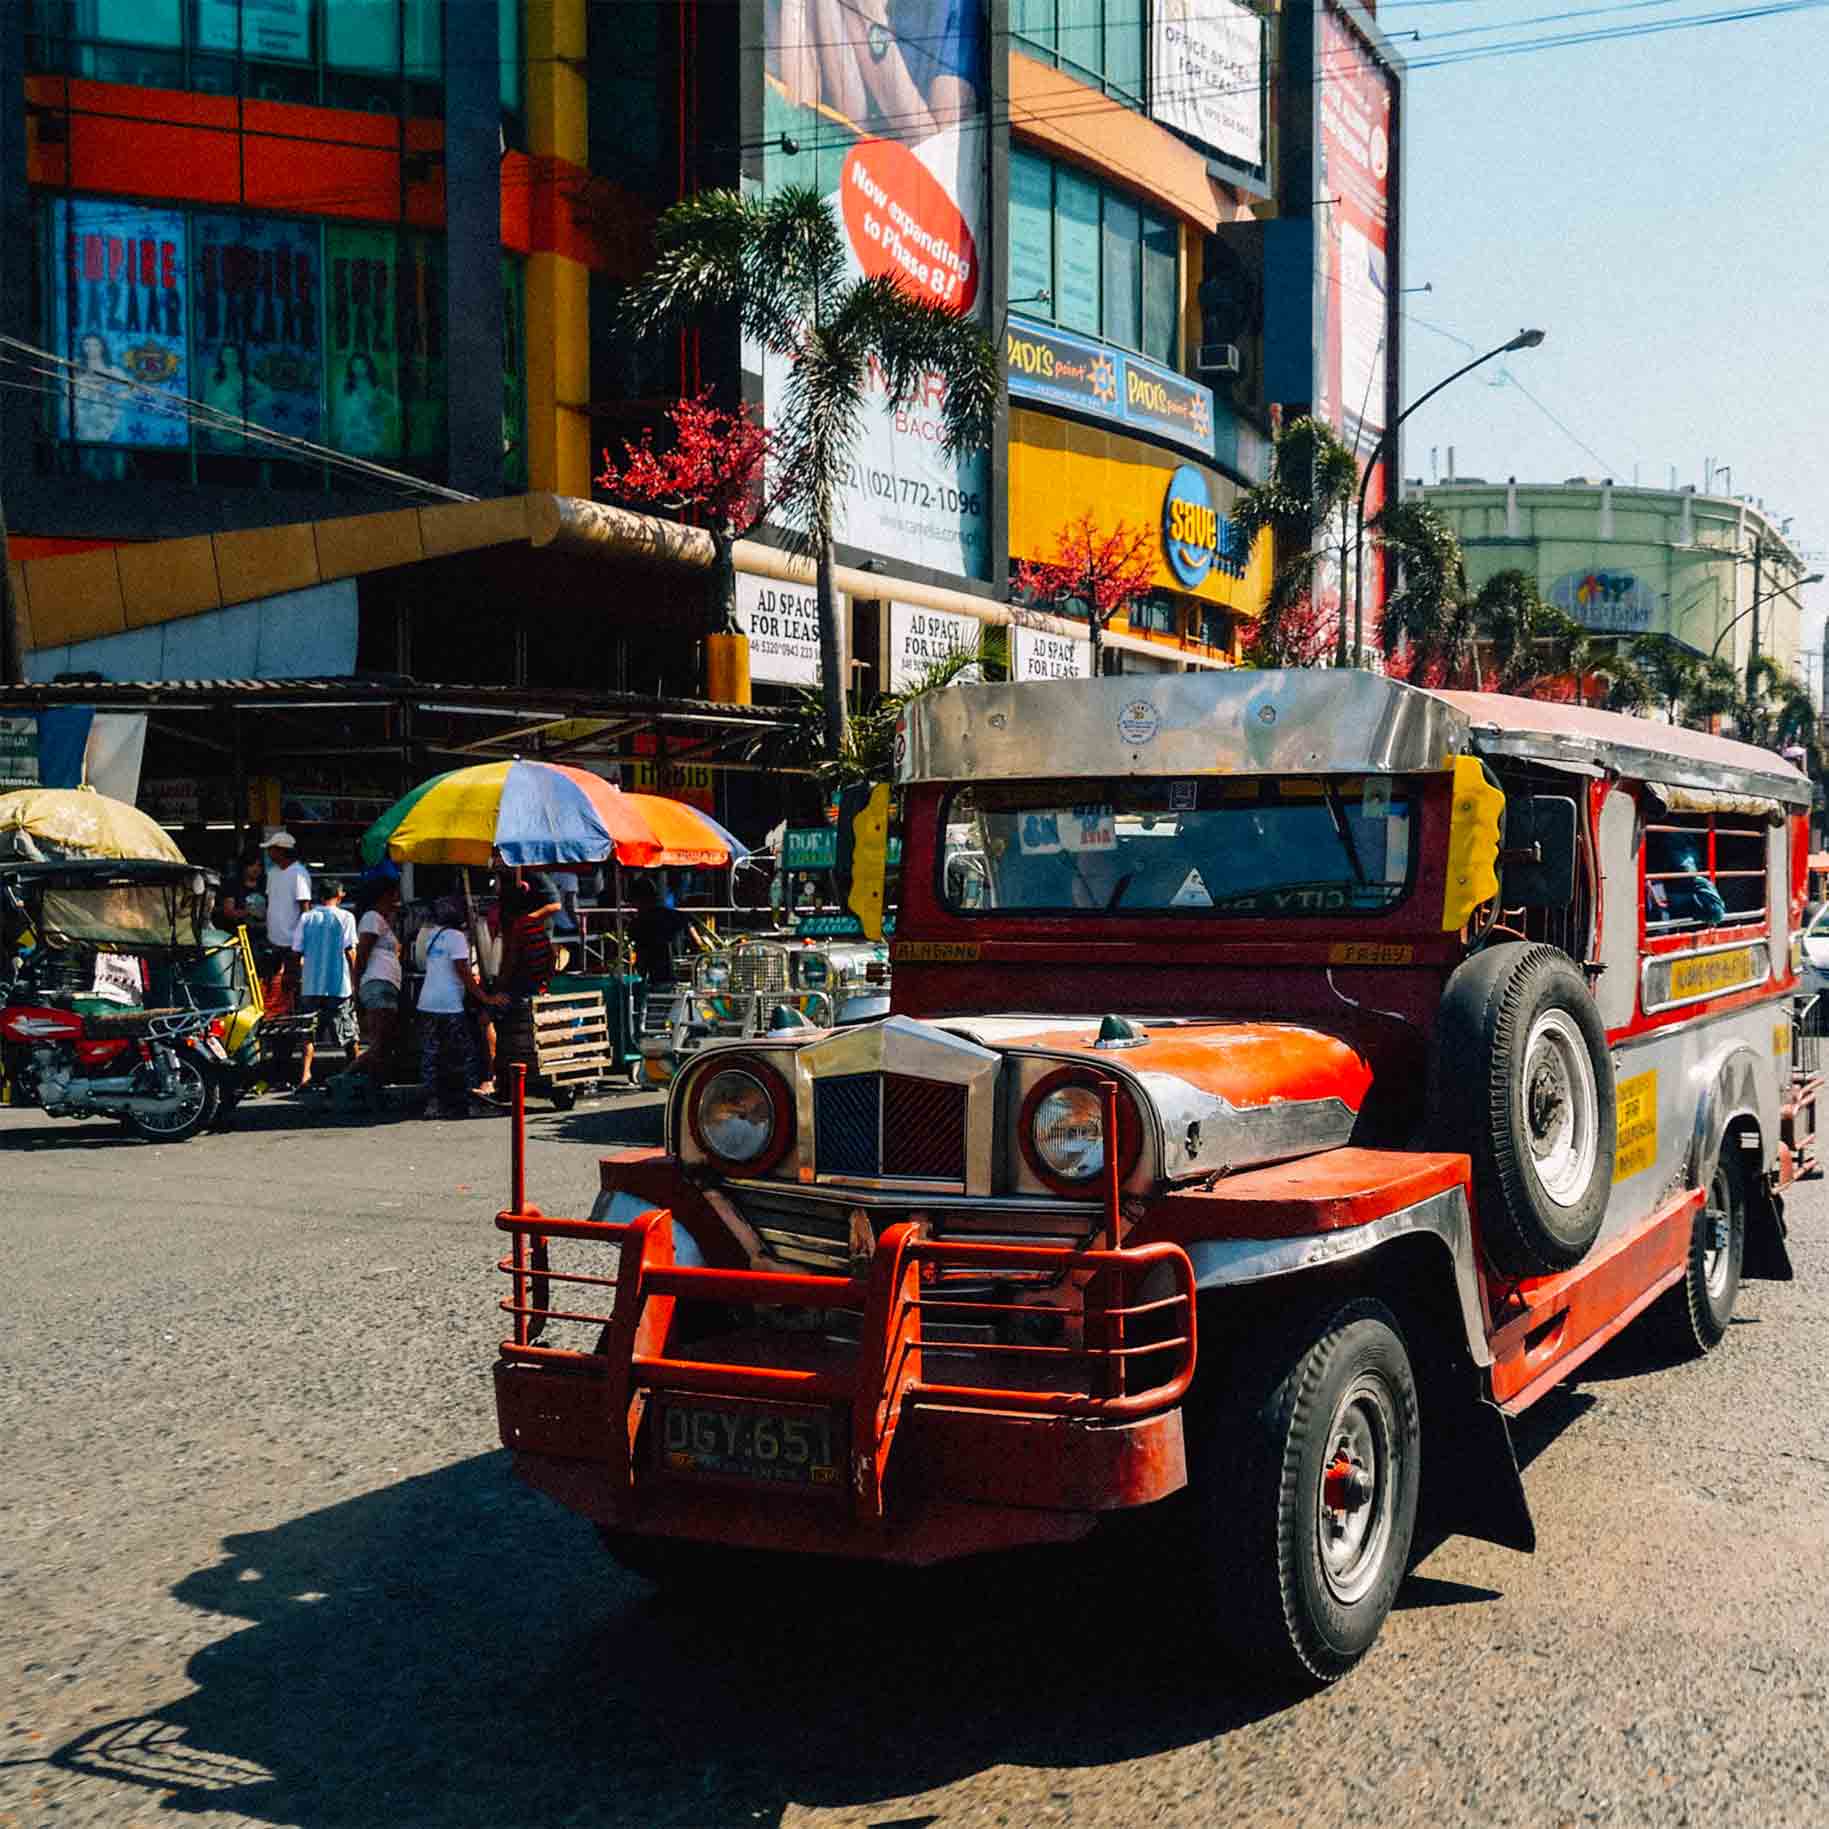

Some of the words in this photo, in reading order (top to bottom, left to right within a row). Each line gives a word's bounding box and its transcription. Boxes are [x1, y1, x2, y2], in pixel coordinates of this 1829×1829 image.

[852, 161, 888, 209] Now
[888, 201, 970, 282] expanding
[864, 212, 881, 241] to
[881, 224, 928, 284] Phase
[930, 267, 956, 300] 8!
[758, 591, 776, 613] AD
[751, 614, 779, 638] FOR
[784, 619, 820, 642] LEAS
[910, 615, 925, 634] AD
[928, 617, 960, 641] SPACE
[904, 637, 928, 657] FOR
[1033, 638, 1049, 657] AD
[1047, 640, 1076, 663] SPACE
[1028, 657, 1048, 677] FOR
[641, 764, 709, 787] HBIB
